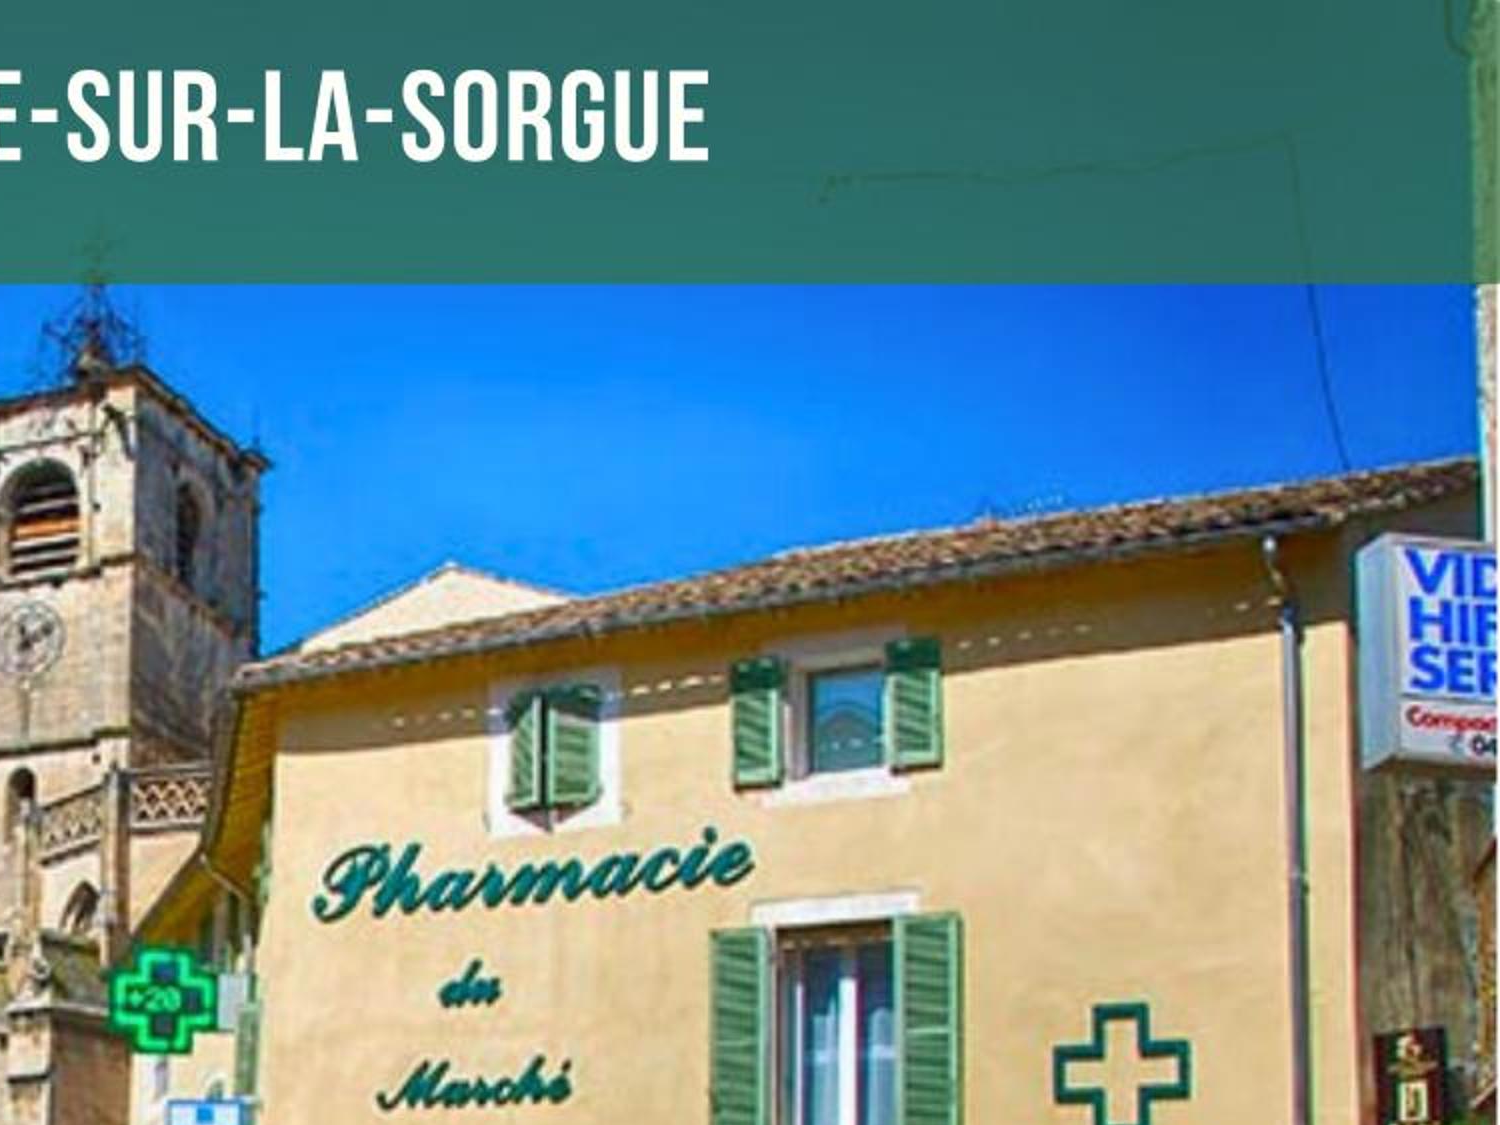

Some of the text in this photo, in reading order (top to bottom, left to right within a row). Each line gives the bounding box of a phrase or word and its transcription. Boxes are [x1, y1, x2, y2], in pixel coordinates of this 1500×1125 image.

[312, 826, 755, 923] Pharmacie
[438, 958, 503, 1008] du
[376, 1054, 572, 1112] Marché
